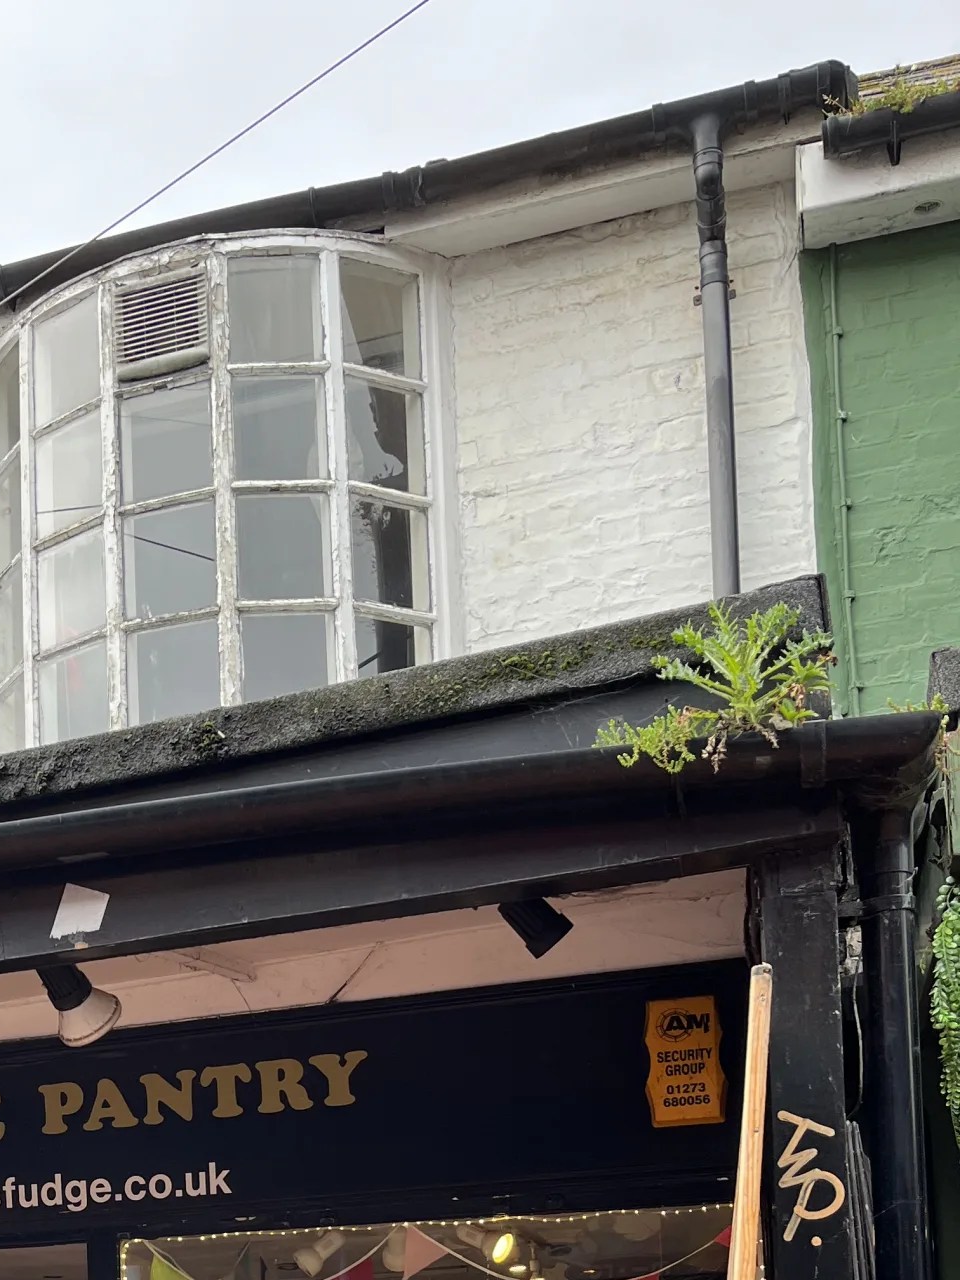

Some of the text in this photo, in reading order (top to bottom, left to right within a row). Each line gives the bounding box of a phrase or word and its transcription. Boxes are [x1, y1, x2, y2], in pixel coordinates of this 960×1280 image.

[657, 1047, 712, 1063] SECURITY
[665, 1062, 706, 1076] GROUP
[38, 1050, 368, 1135] PANTRY
[666, 1082, 706, 1095] 01273
[663, 1094, 711, 1107] 680056
